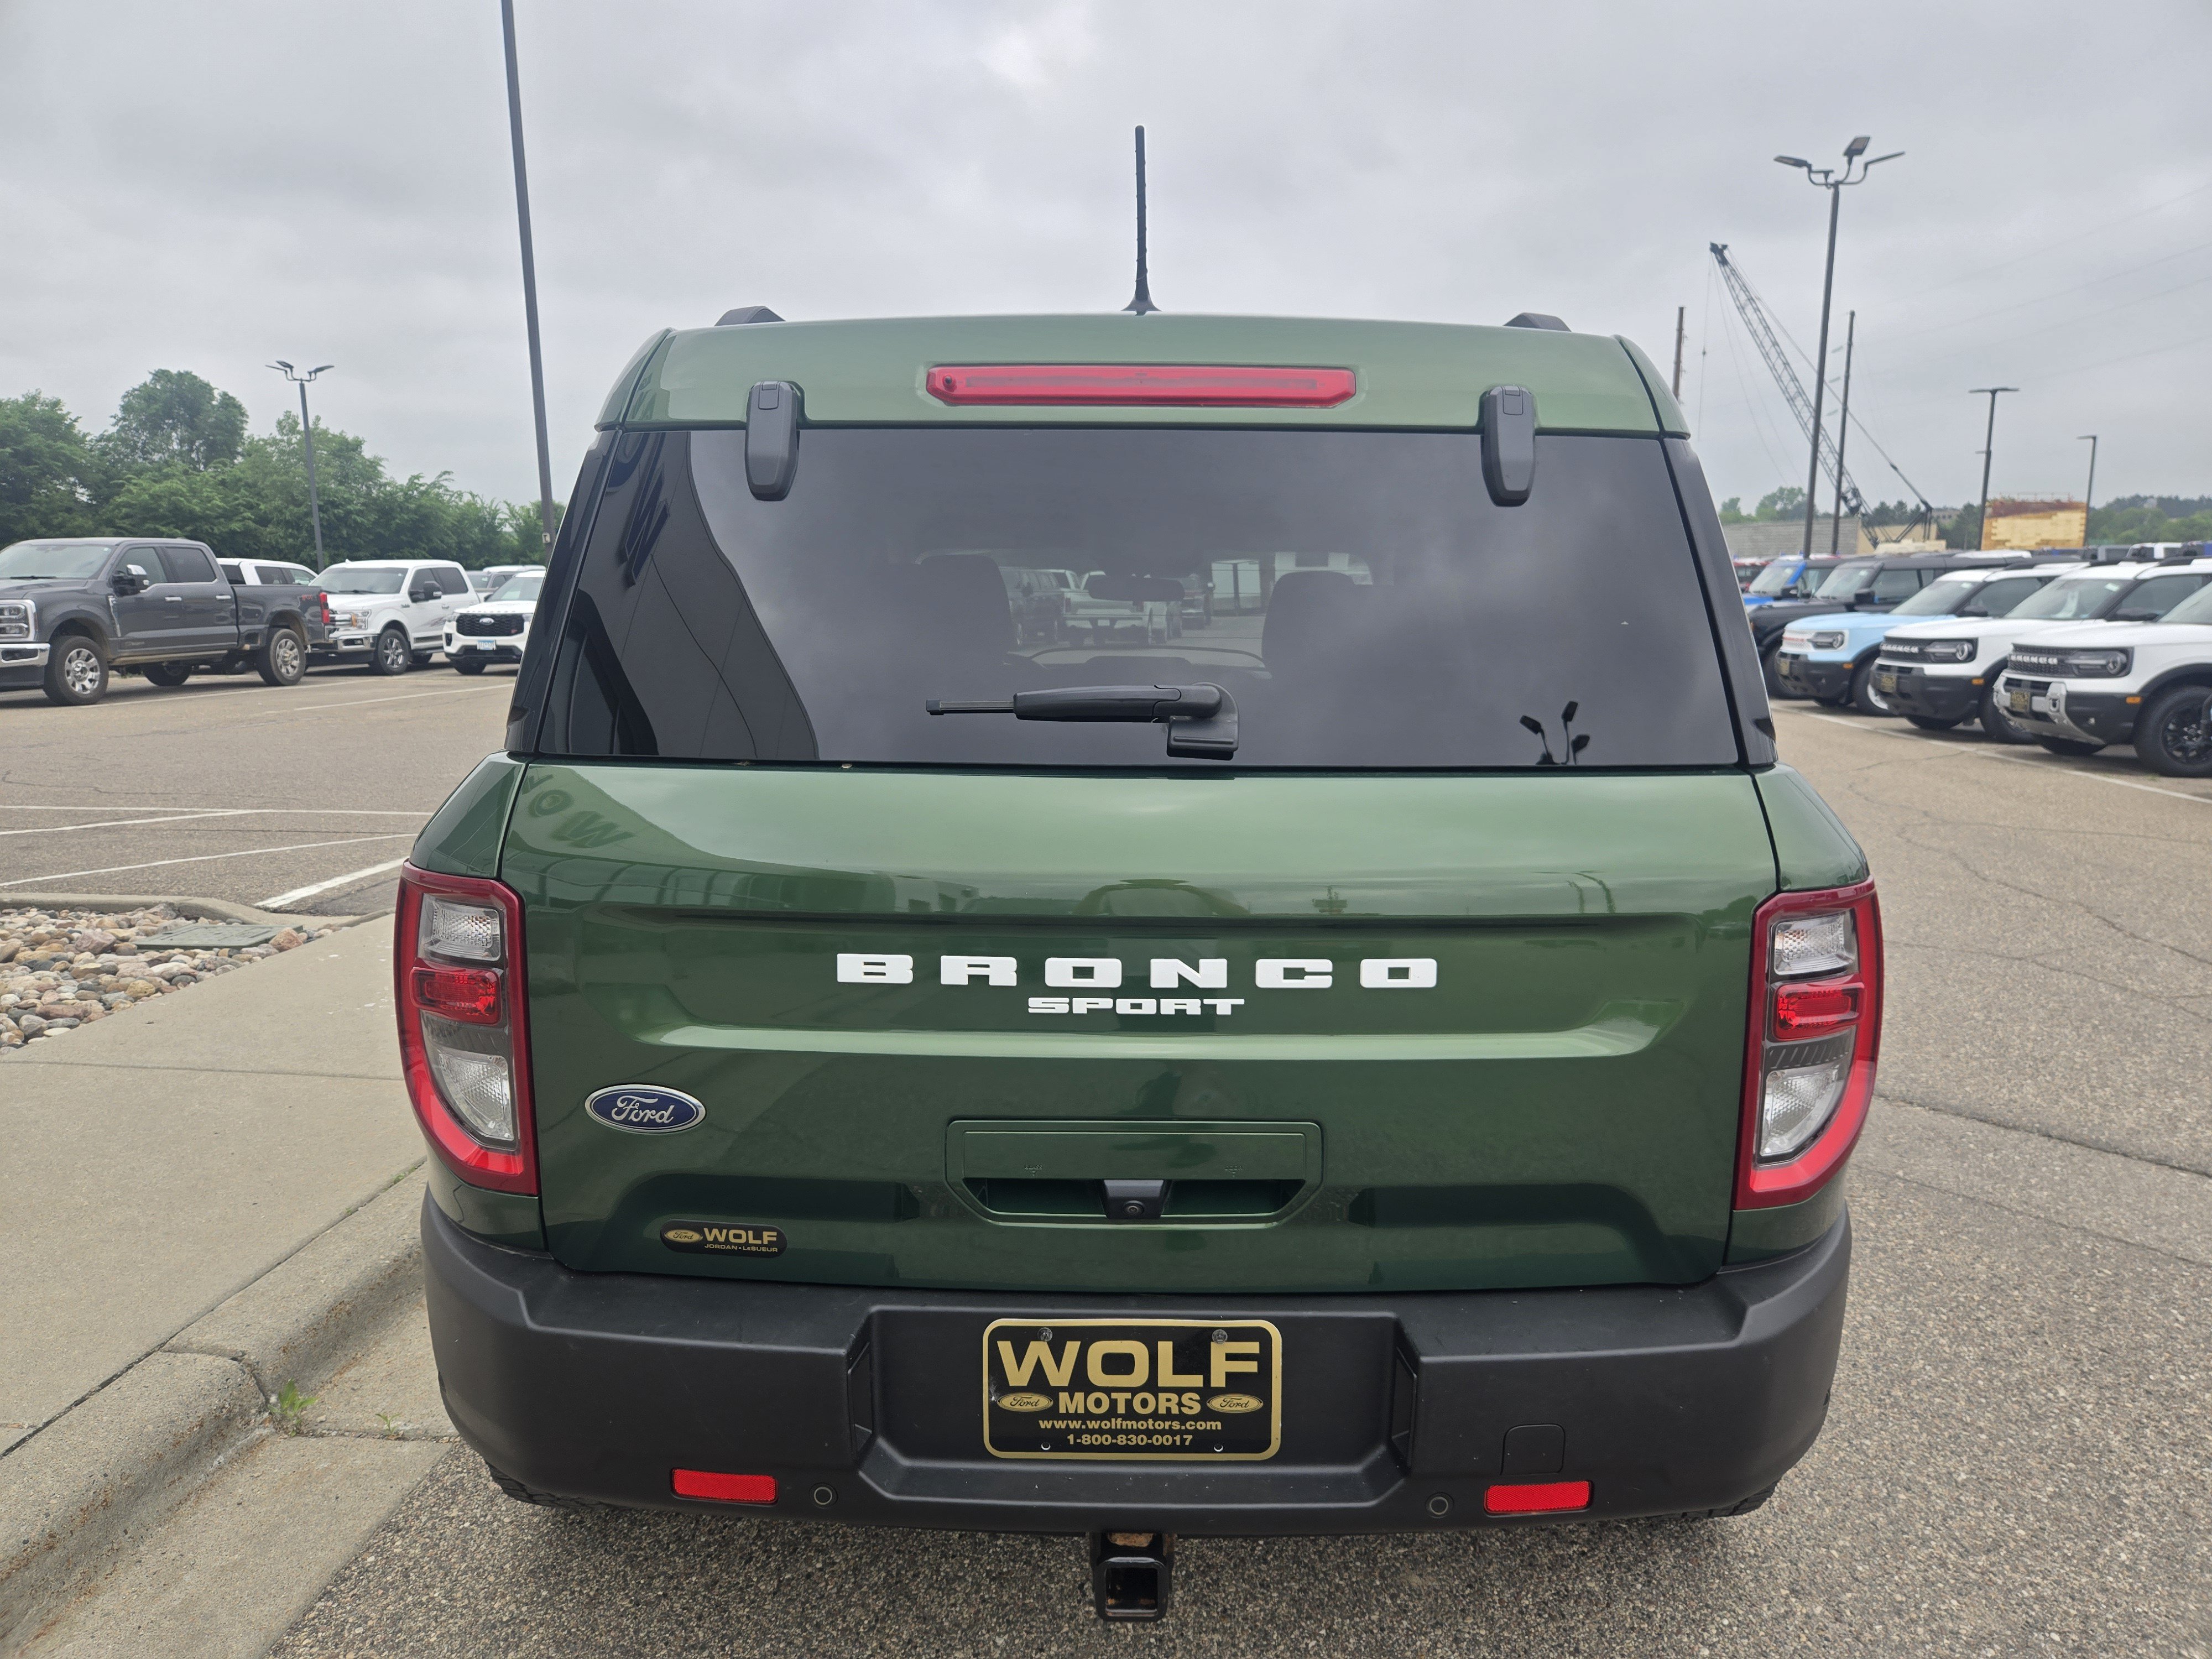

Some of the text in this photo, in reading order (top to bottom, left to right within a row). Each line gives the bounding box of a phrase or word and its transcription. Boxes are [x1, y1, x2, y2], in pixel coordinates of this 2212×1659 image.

[837, 953, 1438, 988] BRONCO
[1027, 997, 1245, 1015] SPORT
[611, 1095, 675, 1123] Ford
[673, 1231, 694, 1240] Ford
[703, 1228, 777, 1244] WOLF
[997, 1340, 1260, 1387] WOLF
[1010, 1396, 1040, 1408] Ford
[1058, 1392, 1201, 1415] MOTORS
[1219, 1396, 1249, 1409] Ford
[1039, 1418, 1222, 1430] www.wolfmotors.com
[1067, 1434, 1193, 1446] 1-800-830-0017
